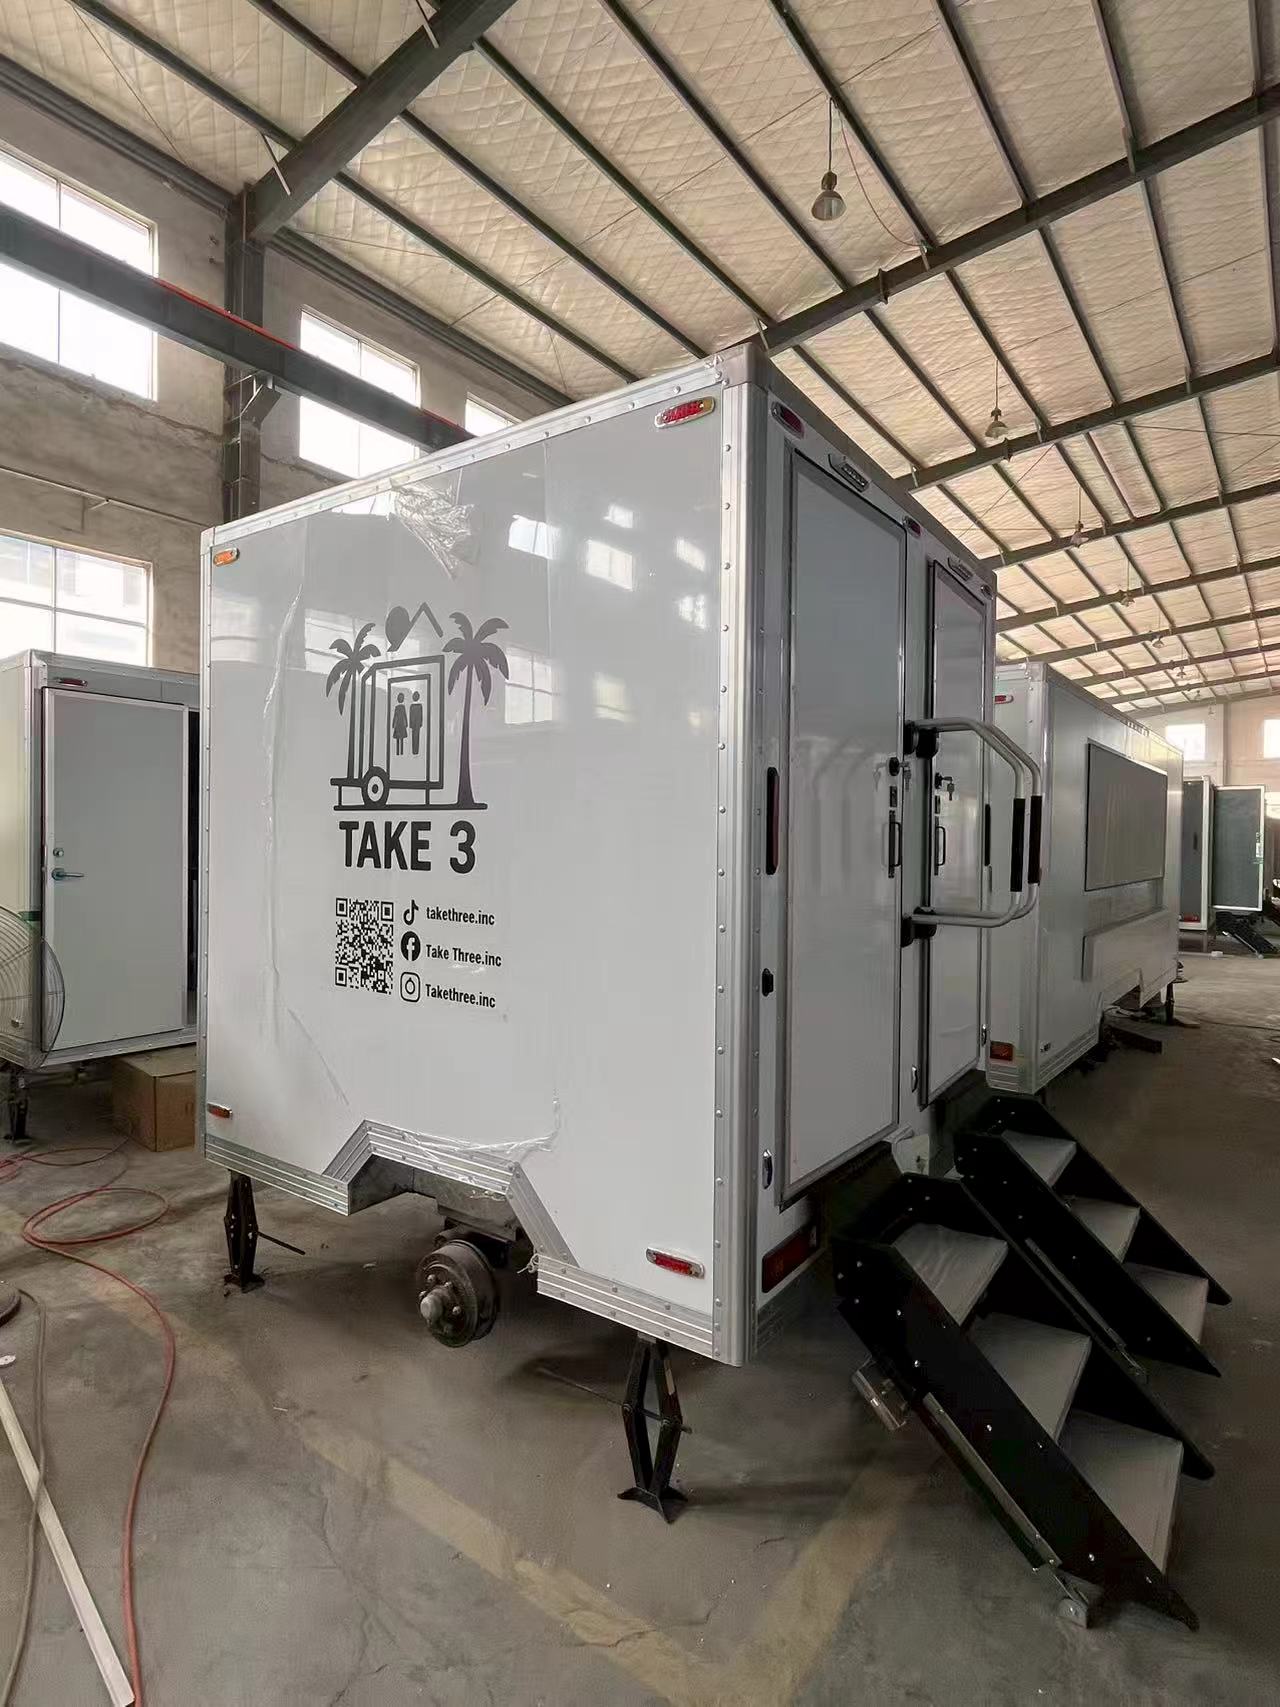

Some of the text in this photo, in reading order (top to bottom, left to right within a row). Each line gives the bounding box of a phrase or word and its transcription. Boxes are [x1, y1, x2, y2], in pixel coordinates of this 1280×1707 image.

[339, 820, 476, 874] TAKE 3
[426, 906, 495, 926] takethree.inc
[425, 944, 502, 967] Take Three.inc
[425, 984, 496, 1008] Takethree.inc
